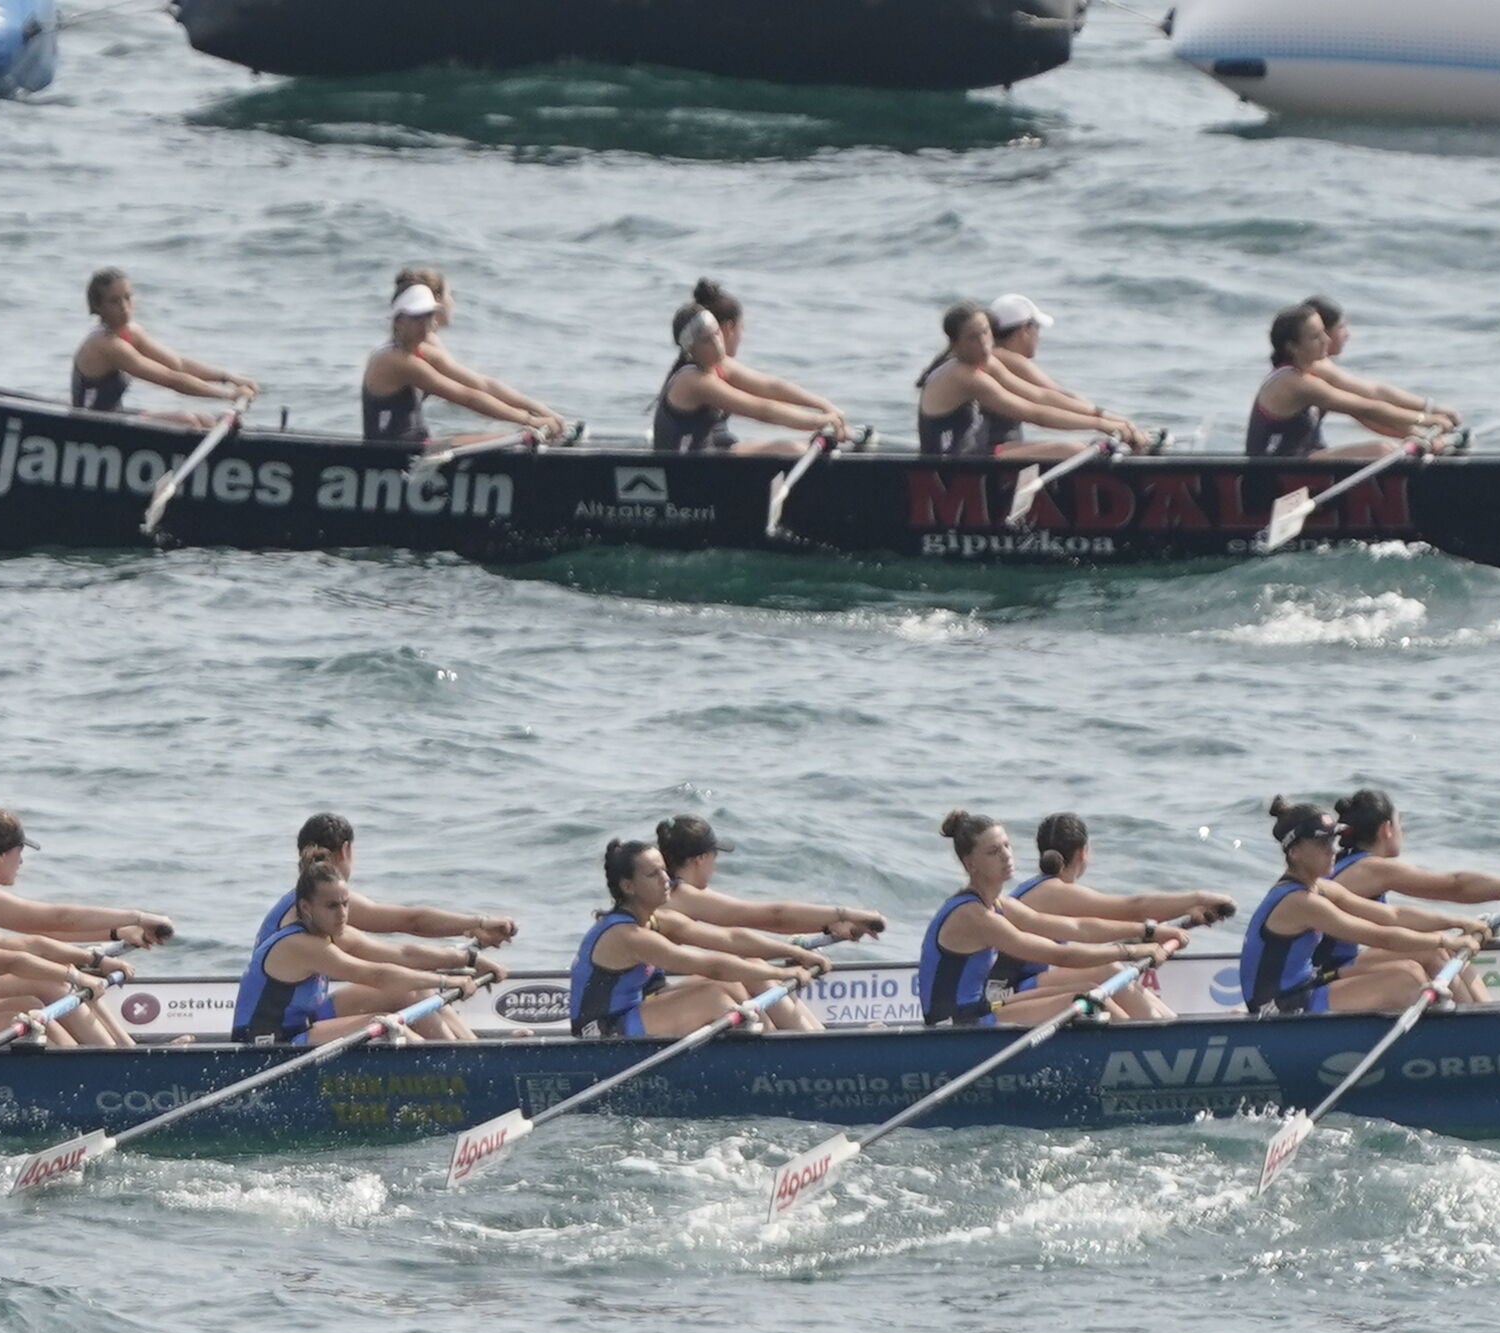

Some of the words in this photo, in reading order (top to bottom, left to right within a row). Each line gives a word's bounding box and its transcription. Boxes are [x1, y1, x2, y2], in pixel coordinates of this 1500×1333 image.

[318, 453, 514, 516] ancín
[797, 972, 899, 1002] ntonio
[168, 998, 235, 1010] ostatua
[751, 1073, 889, 1095] Antonio
